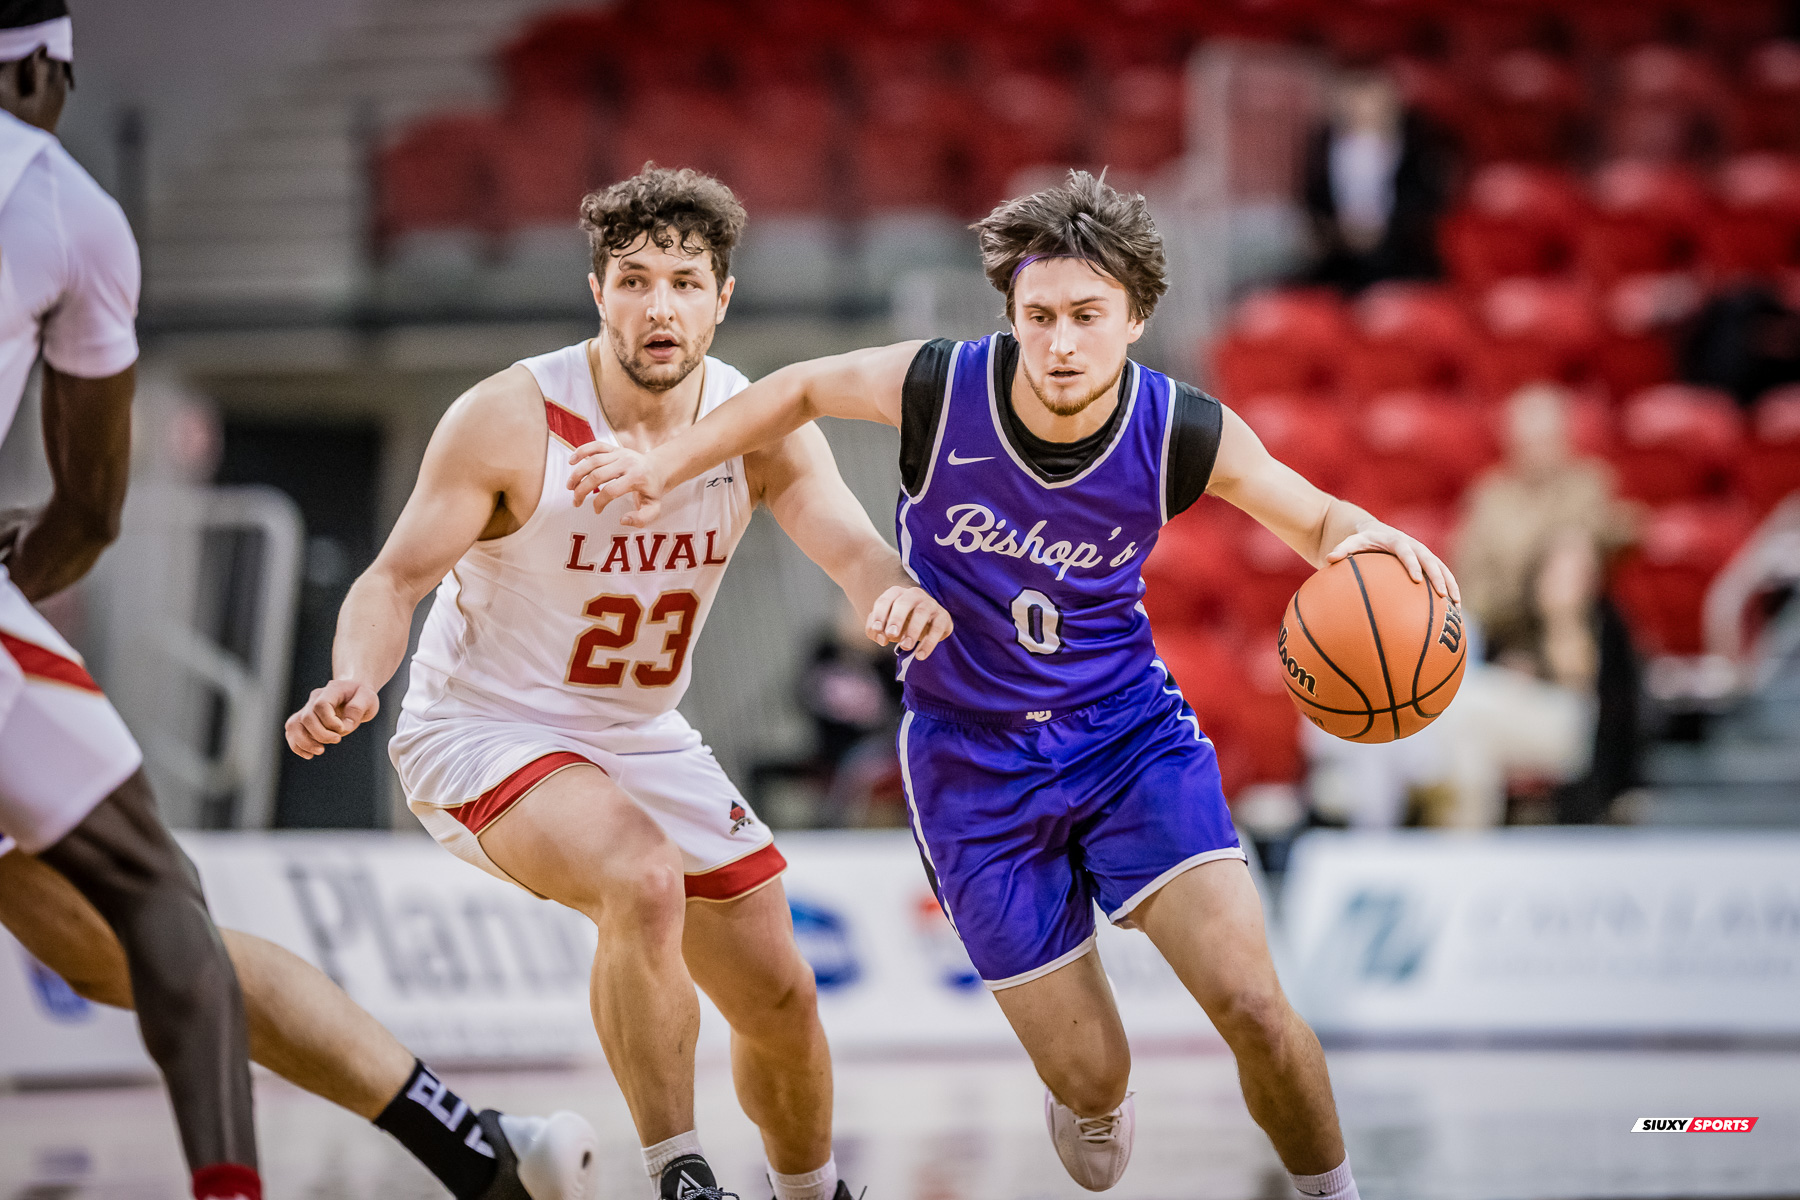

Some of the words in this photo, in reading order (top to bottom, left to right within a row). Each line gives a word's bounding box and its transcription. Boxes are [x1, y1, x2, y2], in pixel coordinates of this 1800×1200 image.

[564, 528, 728, 574] LAVAL
[934, 503, 1139, 581] Bishop's
[563, 588, 701, 689] 23
[1009, 586, 1065, 656] 0
[1278, 618, 1317, 697] lson
